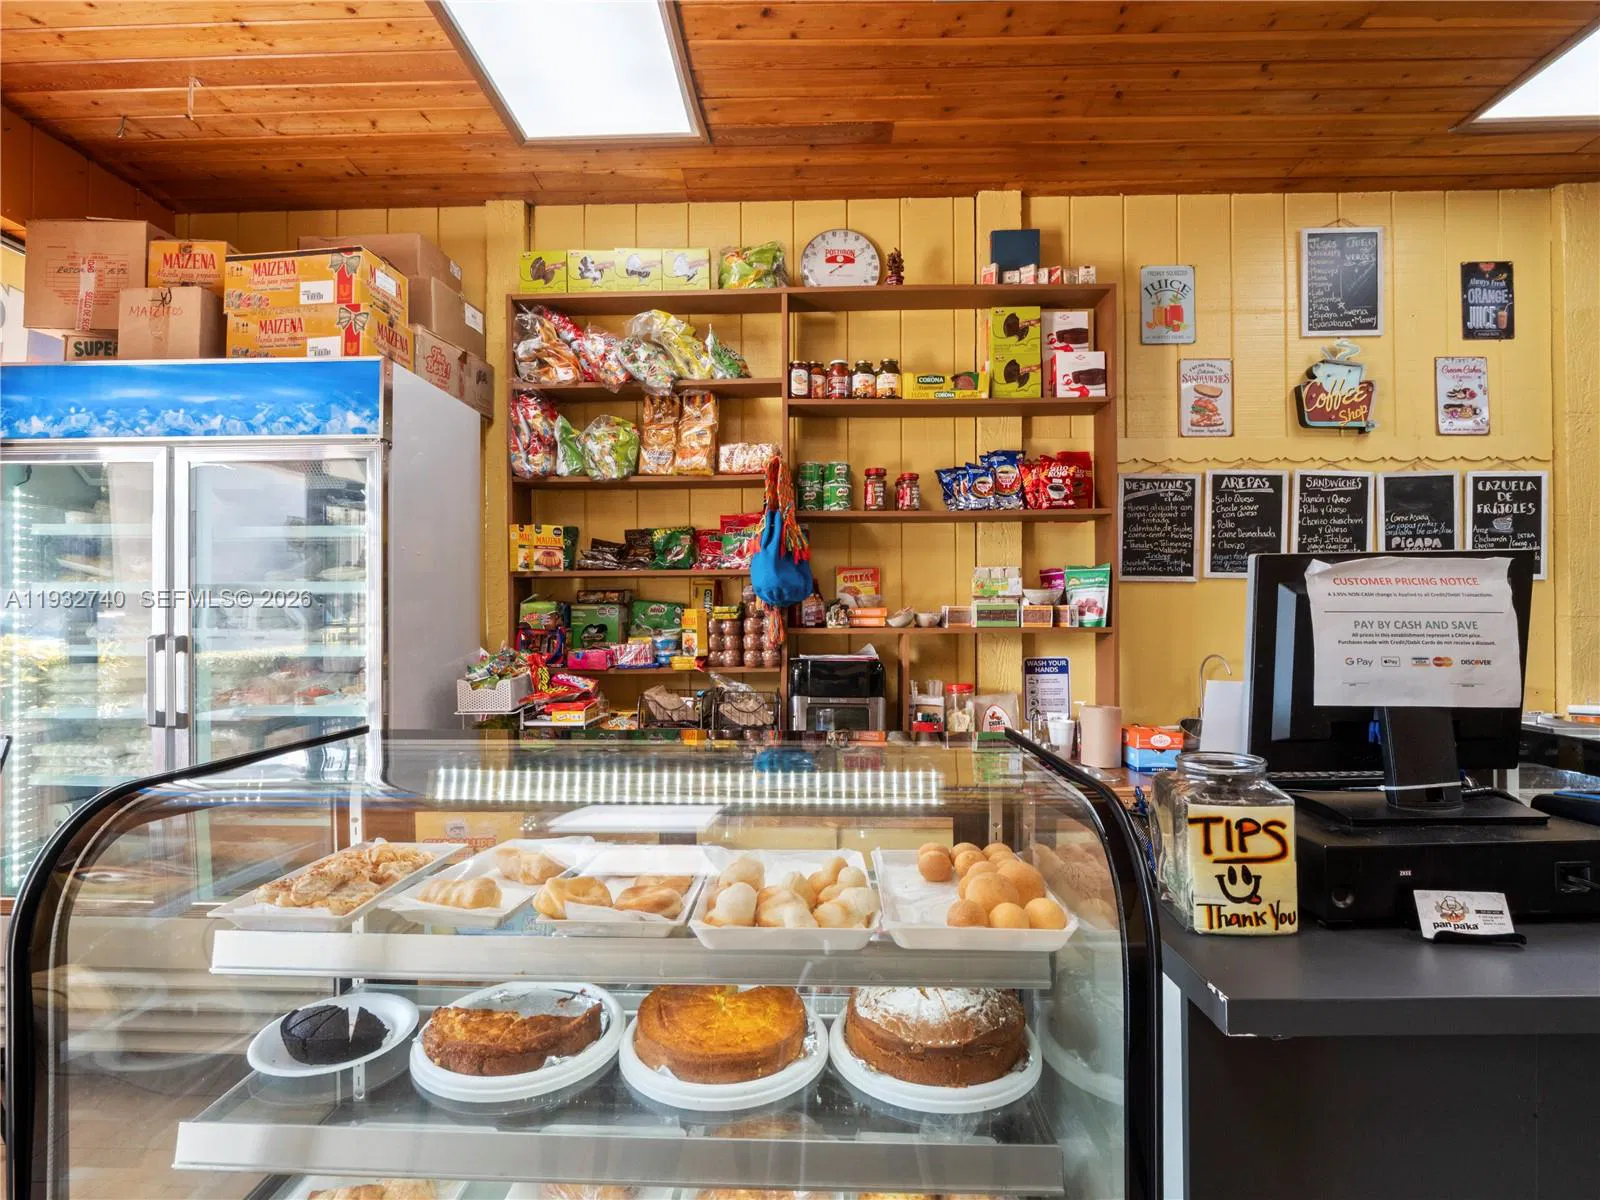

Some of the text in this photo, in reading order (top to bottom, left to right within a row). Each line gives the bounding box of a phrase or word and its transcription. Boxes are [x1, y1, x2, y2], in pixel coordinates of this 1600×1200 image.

[163, 252, 216, 270] MAIZENA
[253, 259, 297, 276] MAIZENA
[1144, 278, 1192, 299] JUICE
[1467, 288, 1509, 304] ORANGE
[259, 317, 303, 334] MAIZENA
[1466, 305, 1497, 330] JUICE
[377, 321, 409, 355] MAIZENA
[918, 376, 945, 385] CORONA
[1303, 379, 1369, 412] Coffee
[1338, 404, 1369, 426] Shop
[1220, 476, 1270, 489] AREPAS
[1477, 480, 1537, 491] CAZUELA
[1497, 492, 1513, 502] DE
[1333, 577, 1480, 586] CUSTOMER PRICING NOTICE
[1353, 620, 1479, 630] PAY BY CASH AND SAVE
[1356, 657, 1374, 668] Pay
[1187, 814, 1289, 861] TIPS
[1196, 899, 1297, 931] Thank You
[1432, 920, 1479, 931] pan paka
